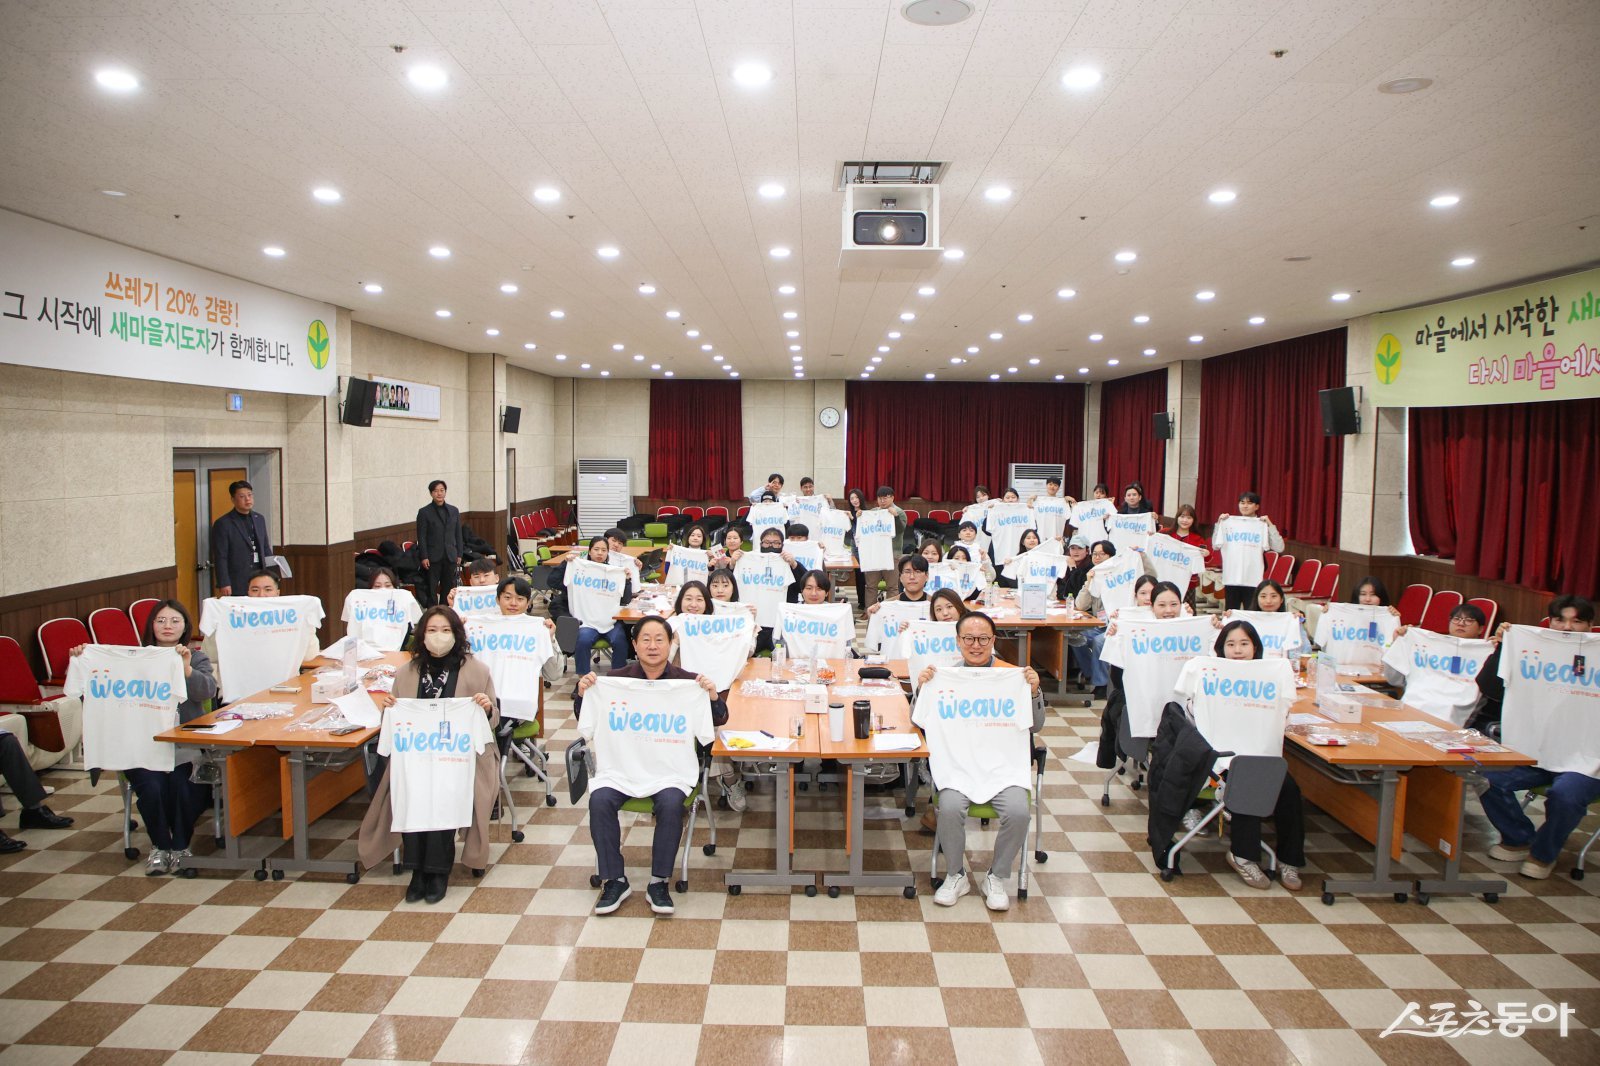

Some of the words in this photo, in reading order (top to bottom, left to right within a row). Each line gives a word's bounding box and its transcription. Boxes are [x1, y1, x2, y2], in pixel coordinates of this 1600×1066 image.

[104, 271, 160, 311] 쓰레기
[166, 287, 200, 318] 20%
[204, 295, 240, 328] 감량!
[2, 291, 28, 321] 그
[37, 296, 102, 338] 시작에
[109, 311, 225, 357] 새마을지도자가
[230, 332, 294, 367] 함께합니다.
[1415, 313, 1488, 353] 마을에서
[1493, 295, 1560, 338] 시작한
[1468, 354, 1509, 385] 다시
[755, 516, 784, 525] weave
[998, 514, 1029, 526] weave
[1226, 532, 1261, 543] weave
[672, 555, 707, 572] weave
[229, 607, 298, 629] weave
[685, 616, 746, 637] weave
[783, 617, 838, 637] weave
[471, 633, 537, 653] weave
[1132, 635, 1201, 655] weave
[90, 677, 172, 701] weave
[1202, 676, 1276, 700] weave
[938, 697, 1016, 719] weave
[609, 710, 688, 735] weave
